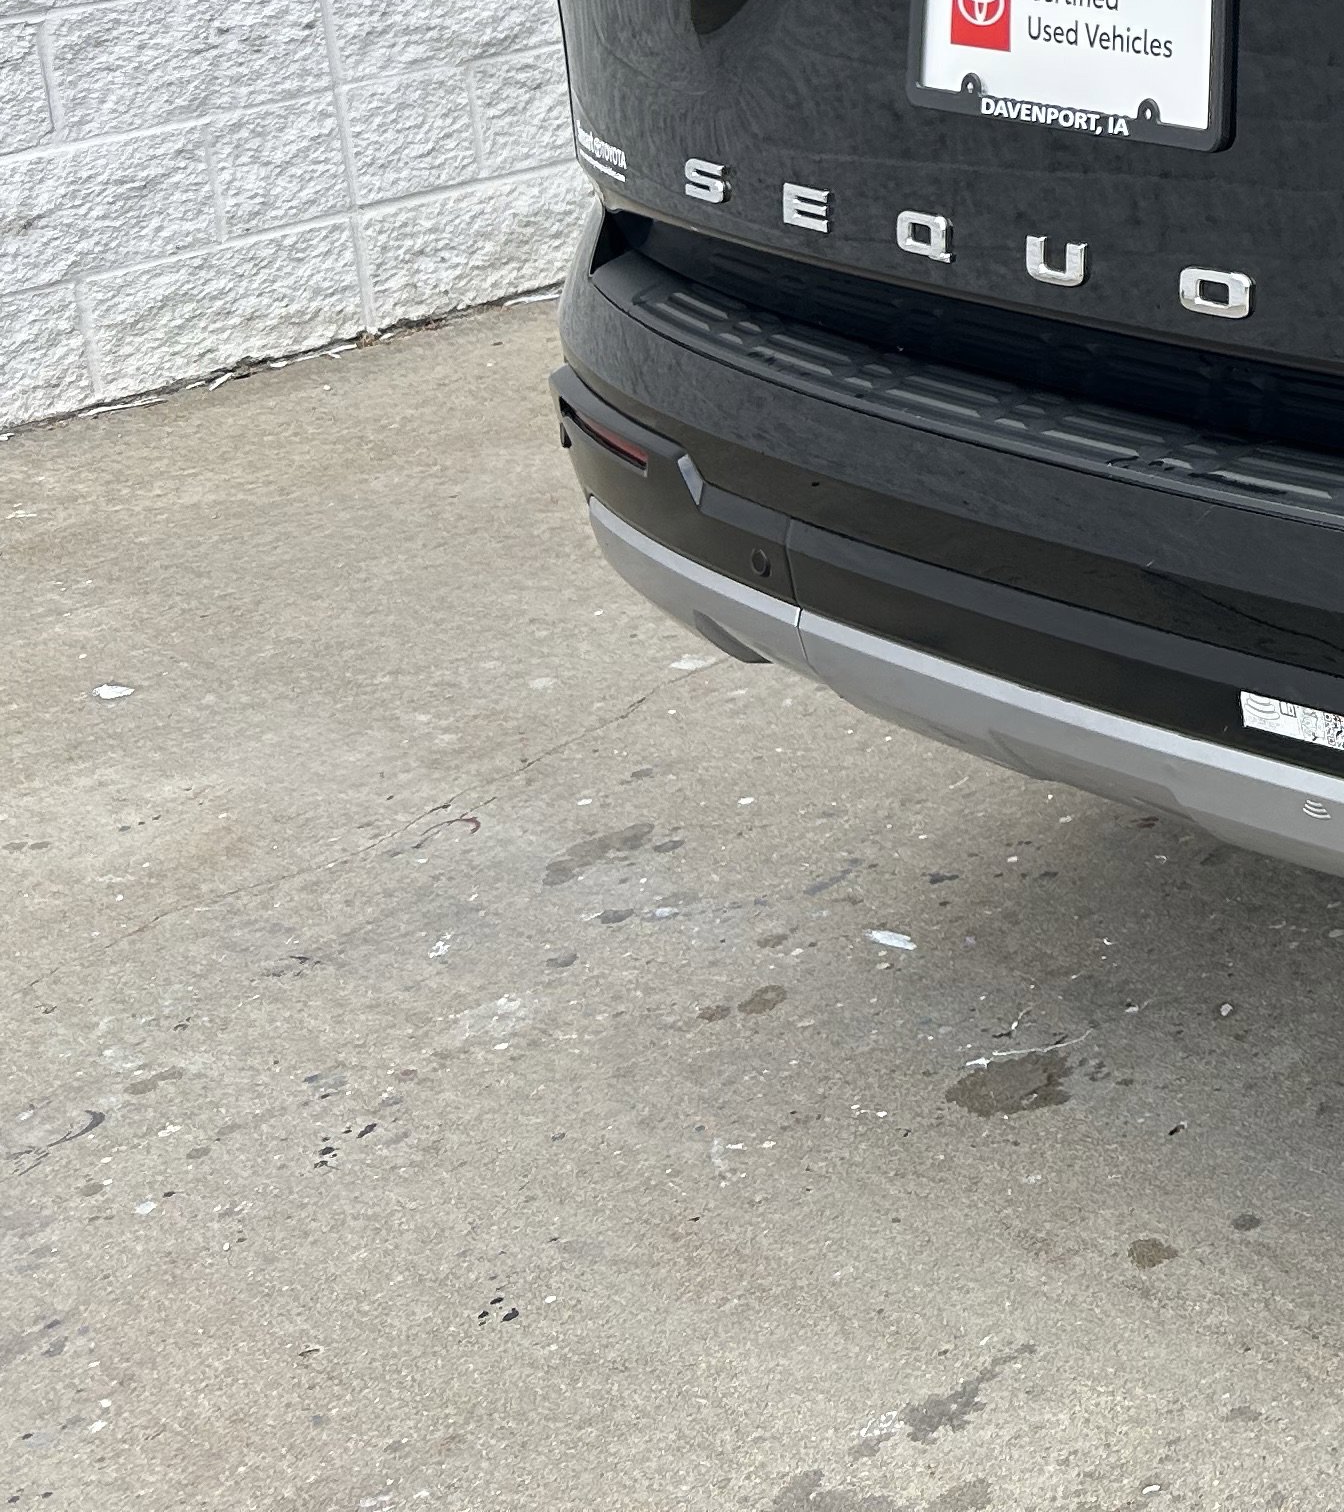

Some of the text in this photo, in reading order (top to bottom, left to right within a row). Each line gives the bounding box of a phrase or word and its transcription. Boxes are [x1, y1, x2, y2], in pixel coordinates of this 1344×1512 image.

[1028, 15, 1173, 59] Used Vehicles
[980, 97, 1130, 137] DAVENPORT, IA
